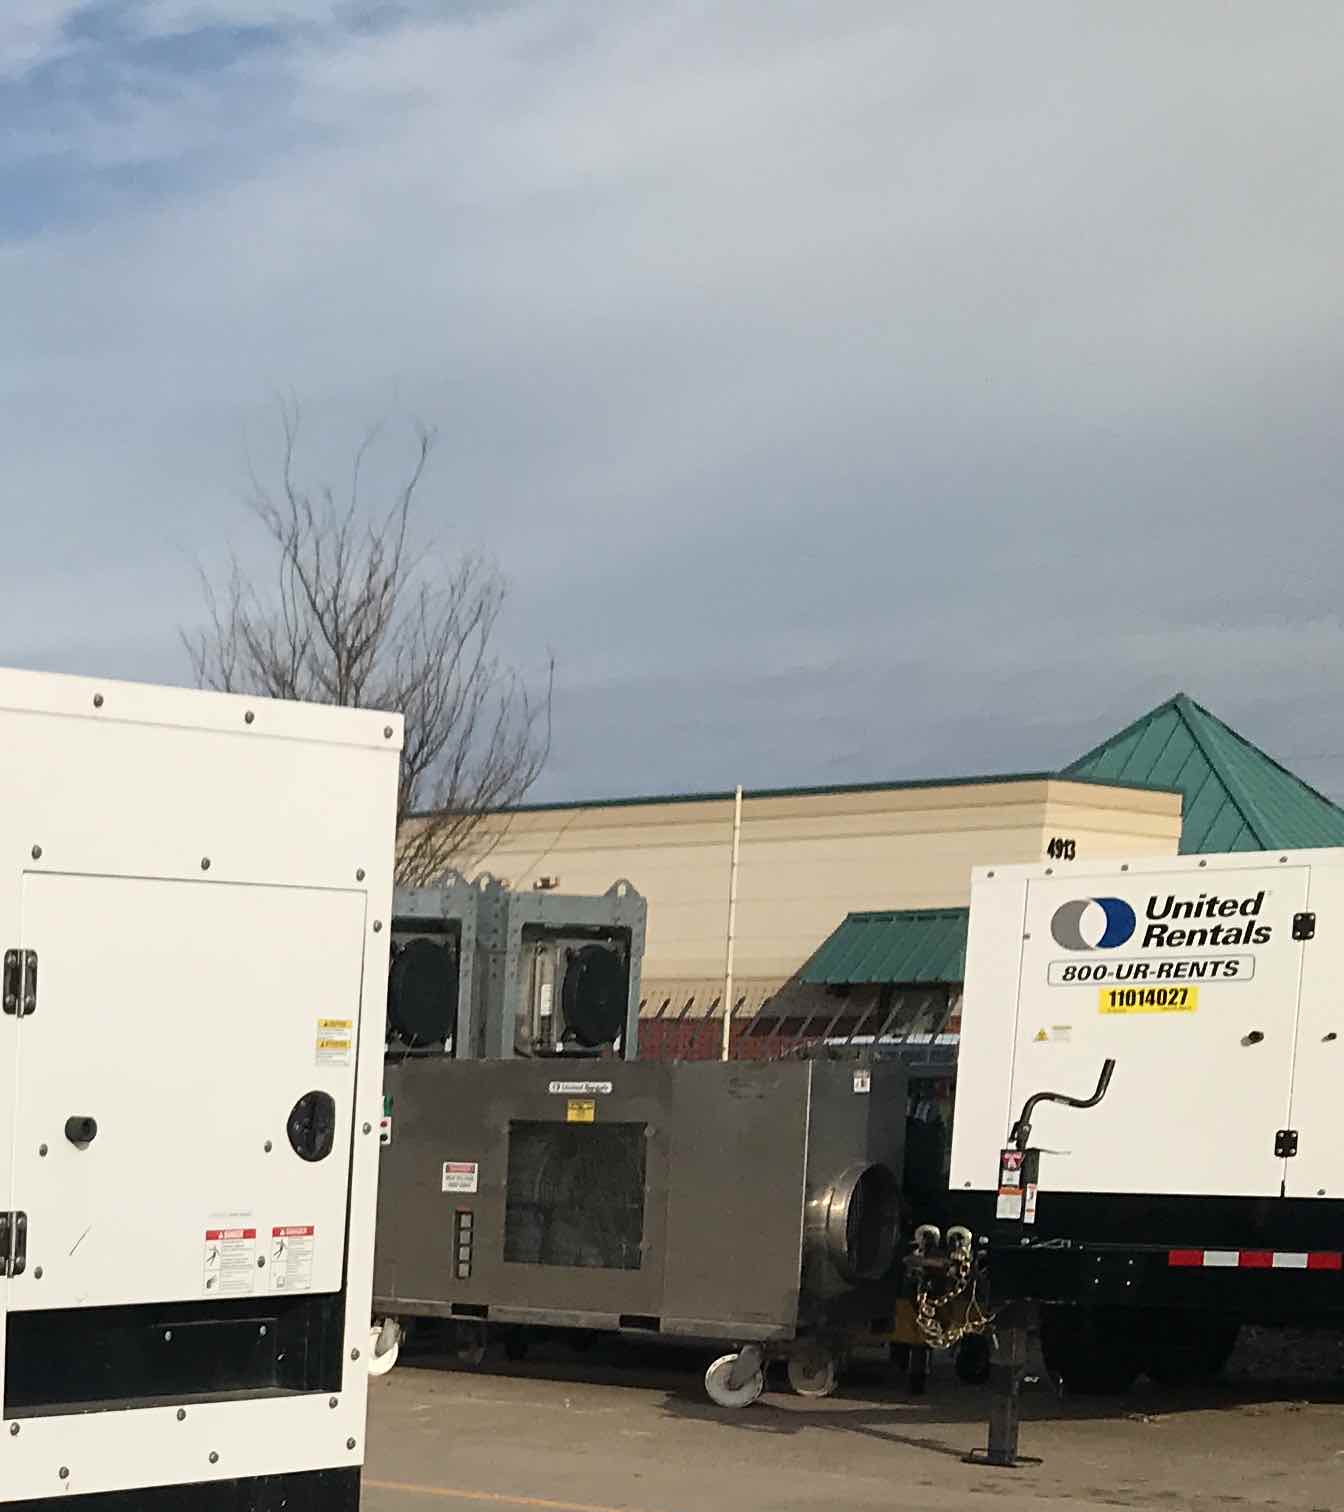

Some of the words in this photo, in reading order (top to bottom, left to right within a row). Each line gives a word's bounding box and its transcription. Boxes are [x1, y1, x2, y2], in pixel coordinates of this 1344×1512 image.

[1047, 837, 1076, 861] 4913
[1145, 891, 1265, 919] United
[1141, 920, 1272, 948] Rentals
[1062, 960, 1240, 981] 800-UR-RENTS
[1108, 988, 1188, 1007] 11014027
